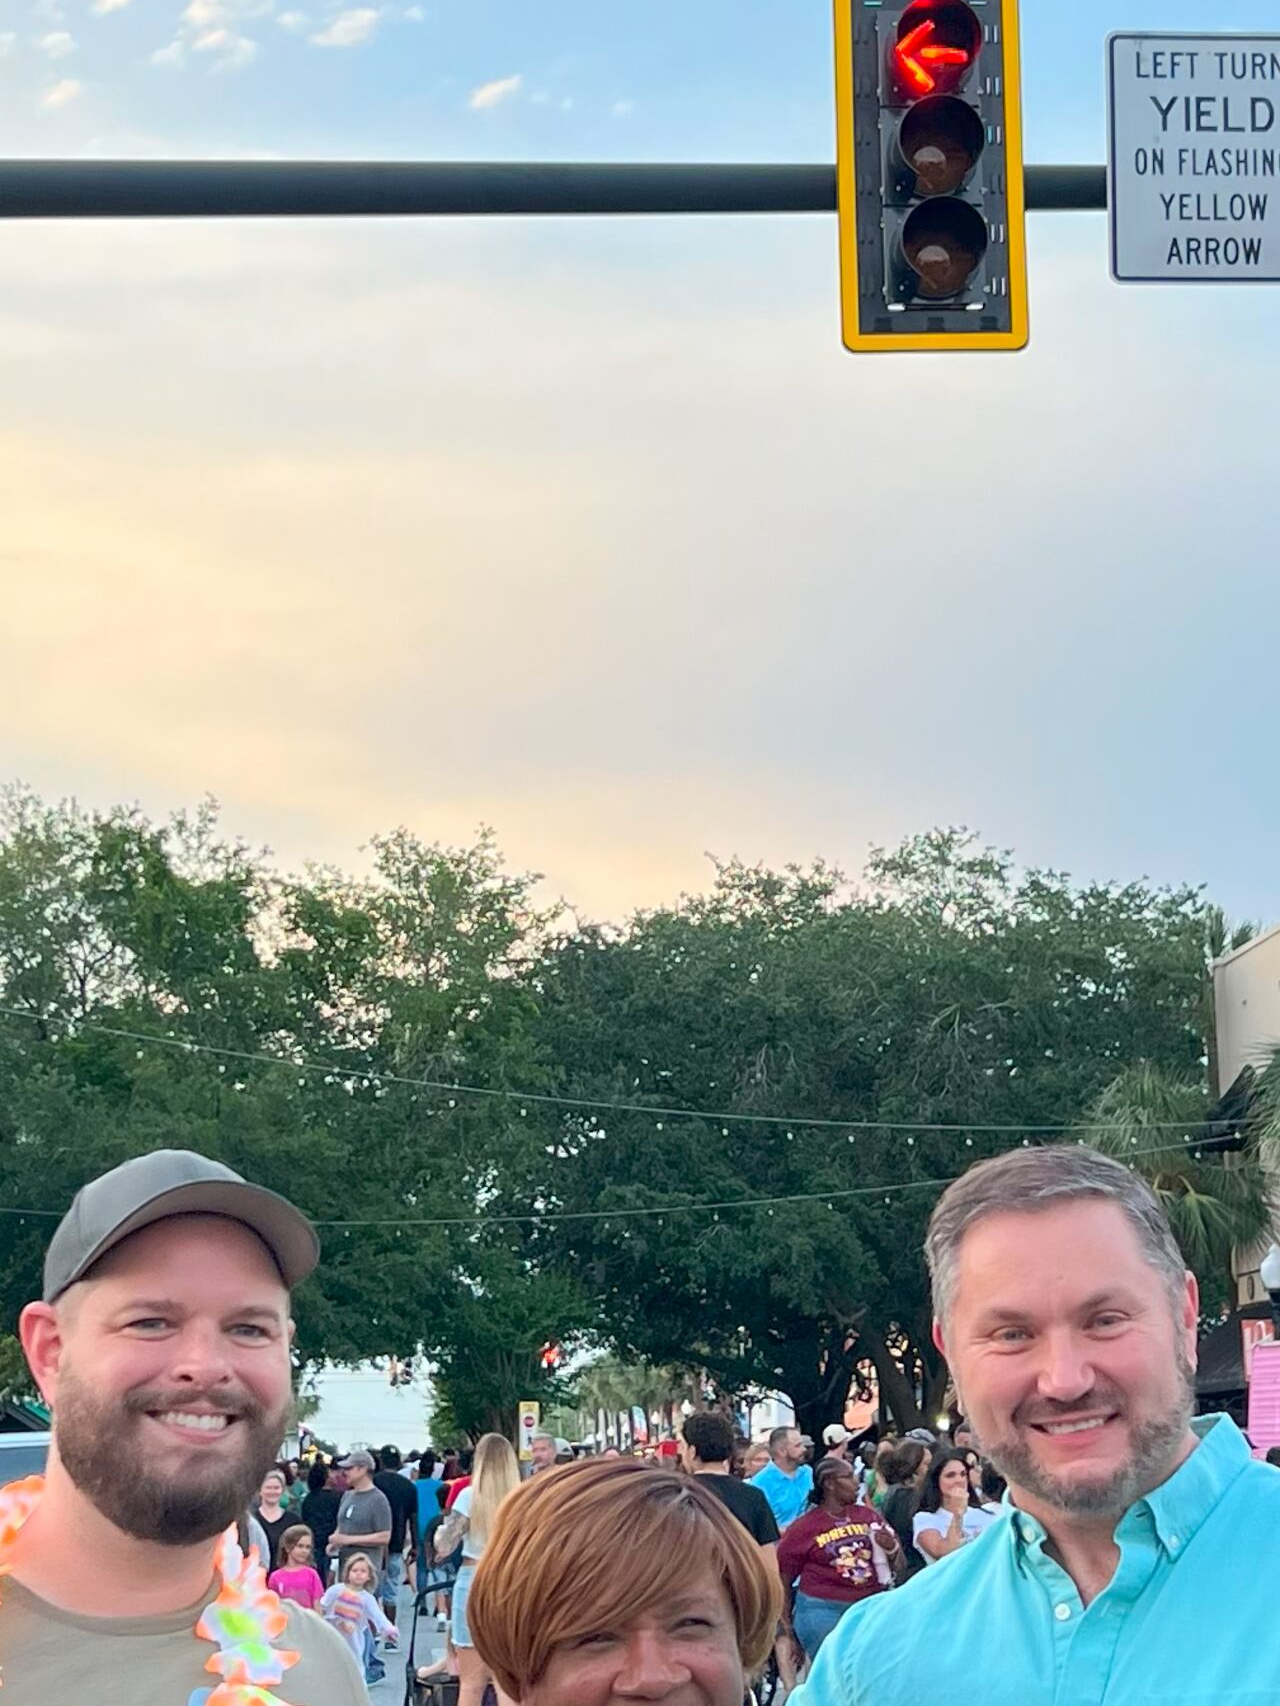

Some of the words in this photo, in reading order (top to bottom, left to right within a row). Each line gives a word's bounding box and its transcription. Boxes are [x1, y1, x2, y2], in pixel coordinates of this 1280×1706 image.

[1136, 51, 1199, 80] LEFT
[1149, 95, 1276, 133] YIELD
[1134, 147, 1165, 176] ON
[1159, 193, 1269, 222] YELLOW
[1166, 237, 1263, 266] ARROW
